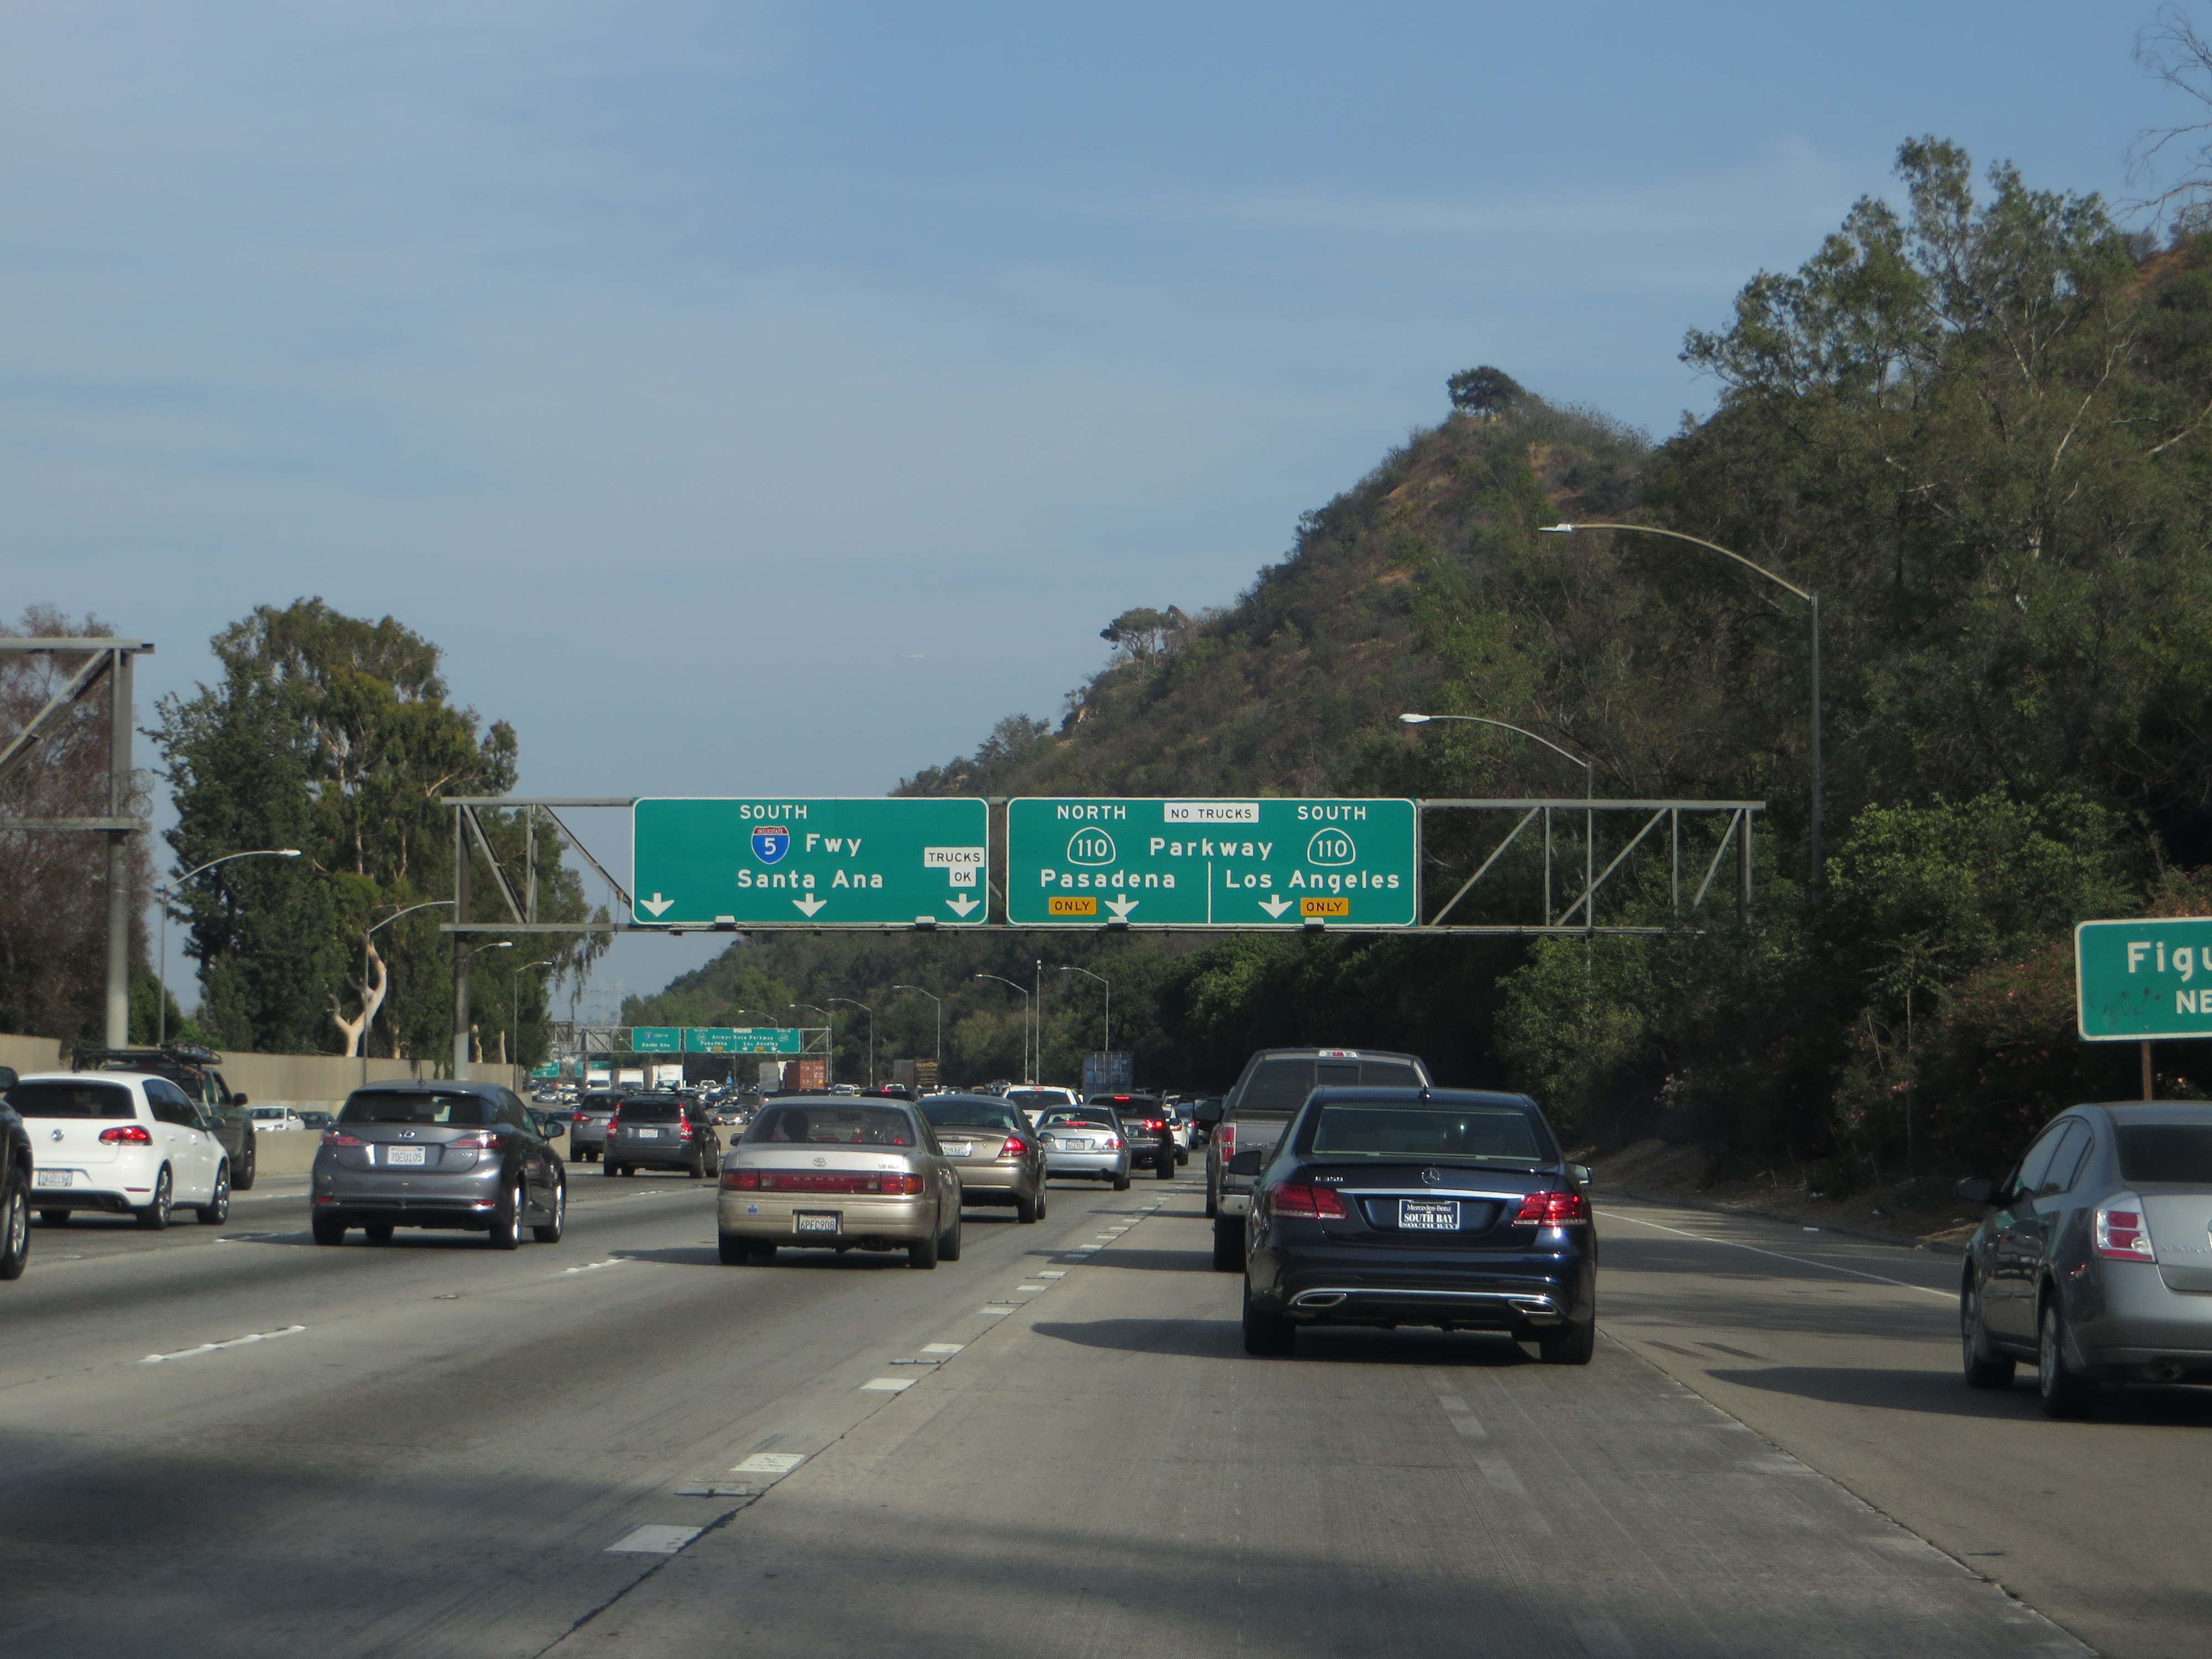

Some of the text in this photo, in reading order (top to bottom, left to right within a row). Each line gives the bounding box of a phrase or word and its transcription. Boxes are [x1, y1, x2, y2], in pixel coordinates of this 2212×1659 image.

[740, 805, 808, 819] SOUTH
[1057, 805, 1126, 820] NORTH
[1171, 809, 1253, 818] NO TRUCKS
[1297, 806, 1367, 820] SOUTH
[765, 837, 776, 855] 5
[806, 833, 862, 857] Fwy
[1078, 839, 1107, 857] 110
[1150, 837, 1273, 860] Parkway
[1317, 840, 1347, 858] 110
[928, 852, 980, 863] TRUCKS
[737, 869, 884, 888] Santa Ana
[955, 871, 971, 882] OK
[1040, 869, 1176, 888] Pasadena
[1225, 869, 1400, 894] Los Angeles
[1055, 901, 1091, 911] ONLY
[1306, 901, 1342, 912] ONLY
[801, 1220, 835, 1230] 6PFC908
[1404, 1213, 1454, 1224] SOUTH BAY
